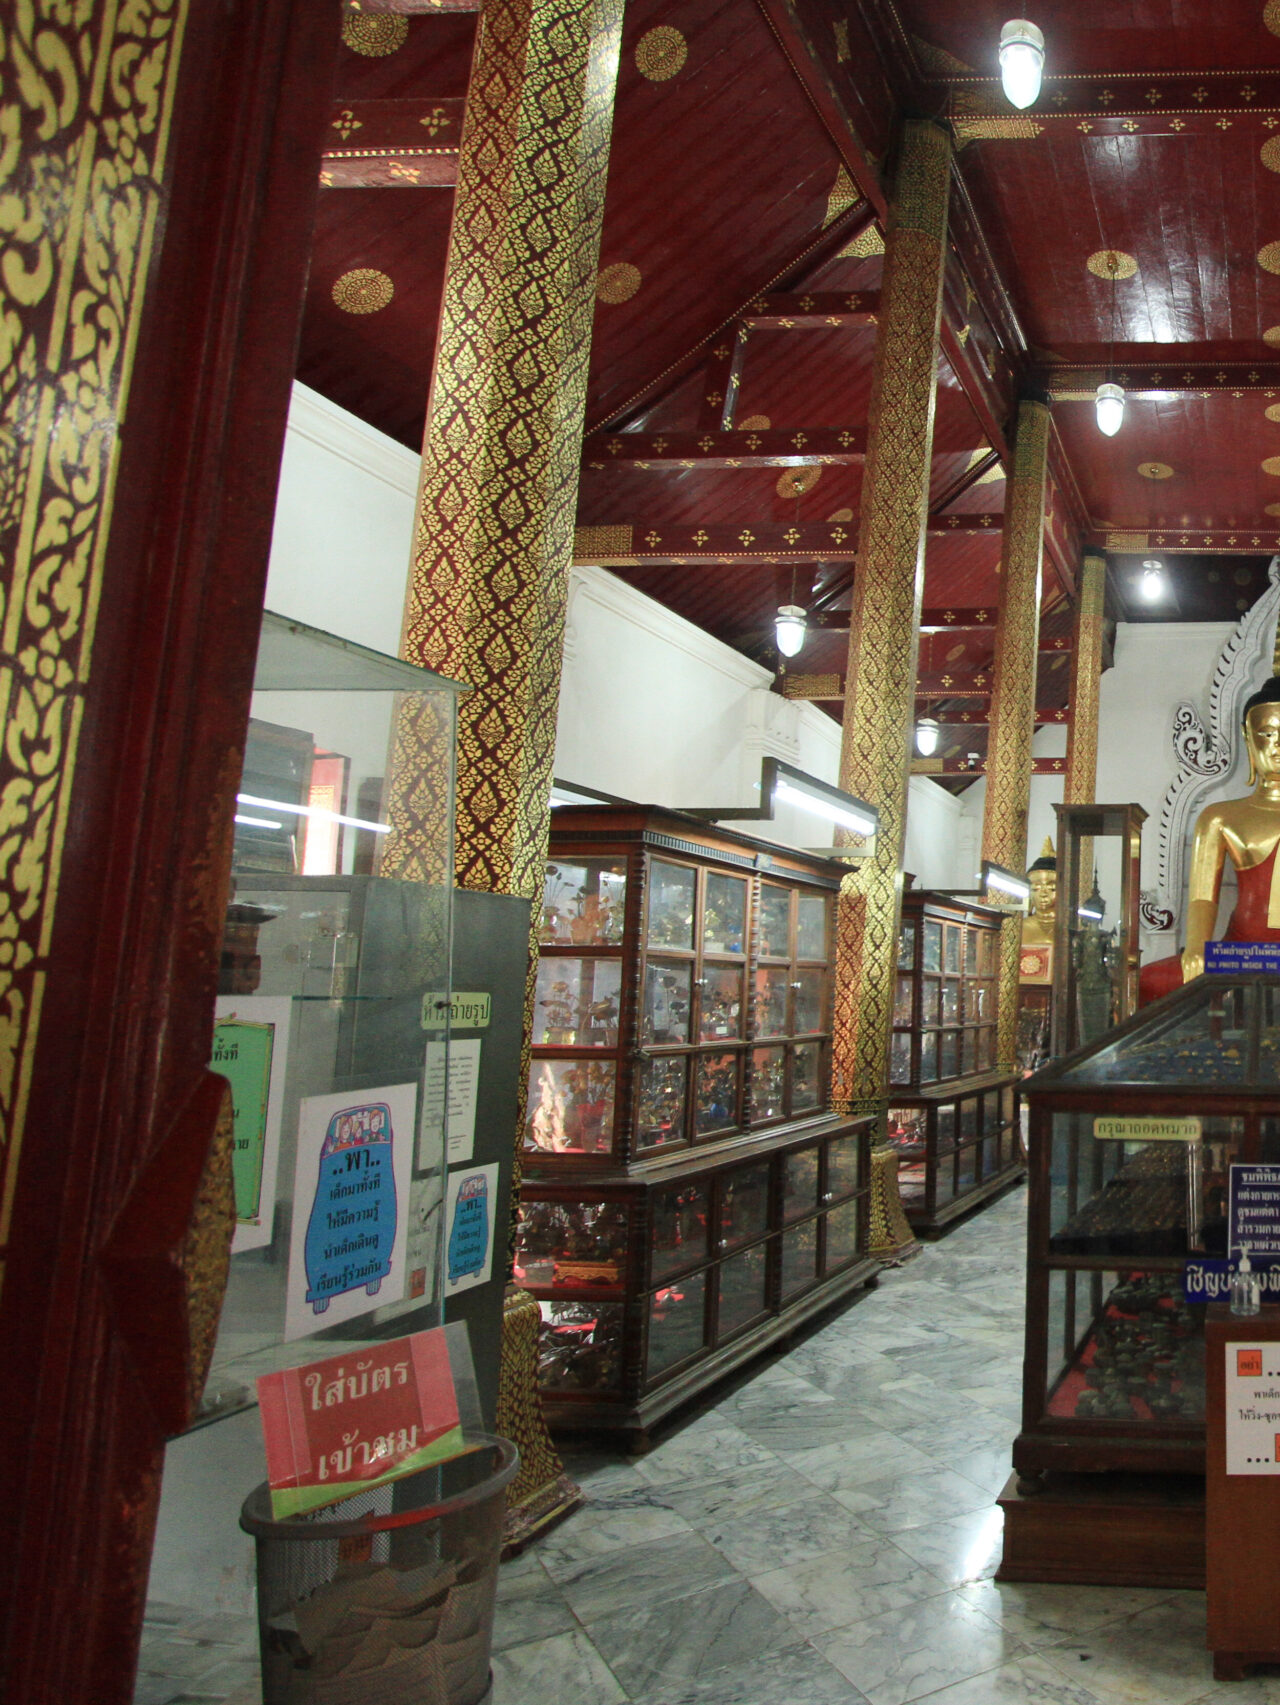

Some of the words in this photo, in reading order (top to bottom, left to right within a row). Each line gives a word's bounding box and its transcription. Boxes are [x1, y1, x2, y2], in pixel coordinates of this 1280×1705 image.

[1219, 961, 1239, 969] PHOTO
[1242, 961, 1263, 970] INSIDE
[1266, 962, 1278, 970] THE
[1098, 1122, 1197, 1138] กรุณาถอดหมวก
[329, 1170, 381, 1200] เด็กมาทั้งที
[326, 1200, 380, 1231] ให้มีความรู้
[1237, 1203, 1280, 1220] ดูชมแต่ตา
[324, 1232, 379, 1260] นำเด็กเดินดู
[316, 1259, 382, 1293] เรียนรู้ร่วมกัน
[1240, 1356, 1260, 1371] อย่า
[305, 1360, 410, 1411] ใส่บัตร
[318, 1425, 418, 1480] เข้าชม
